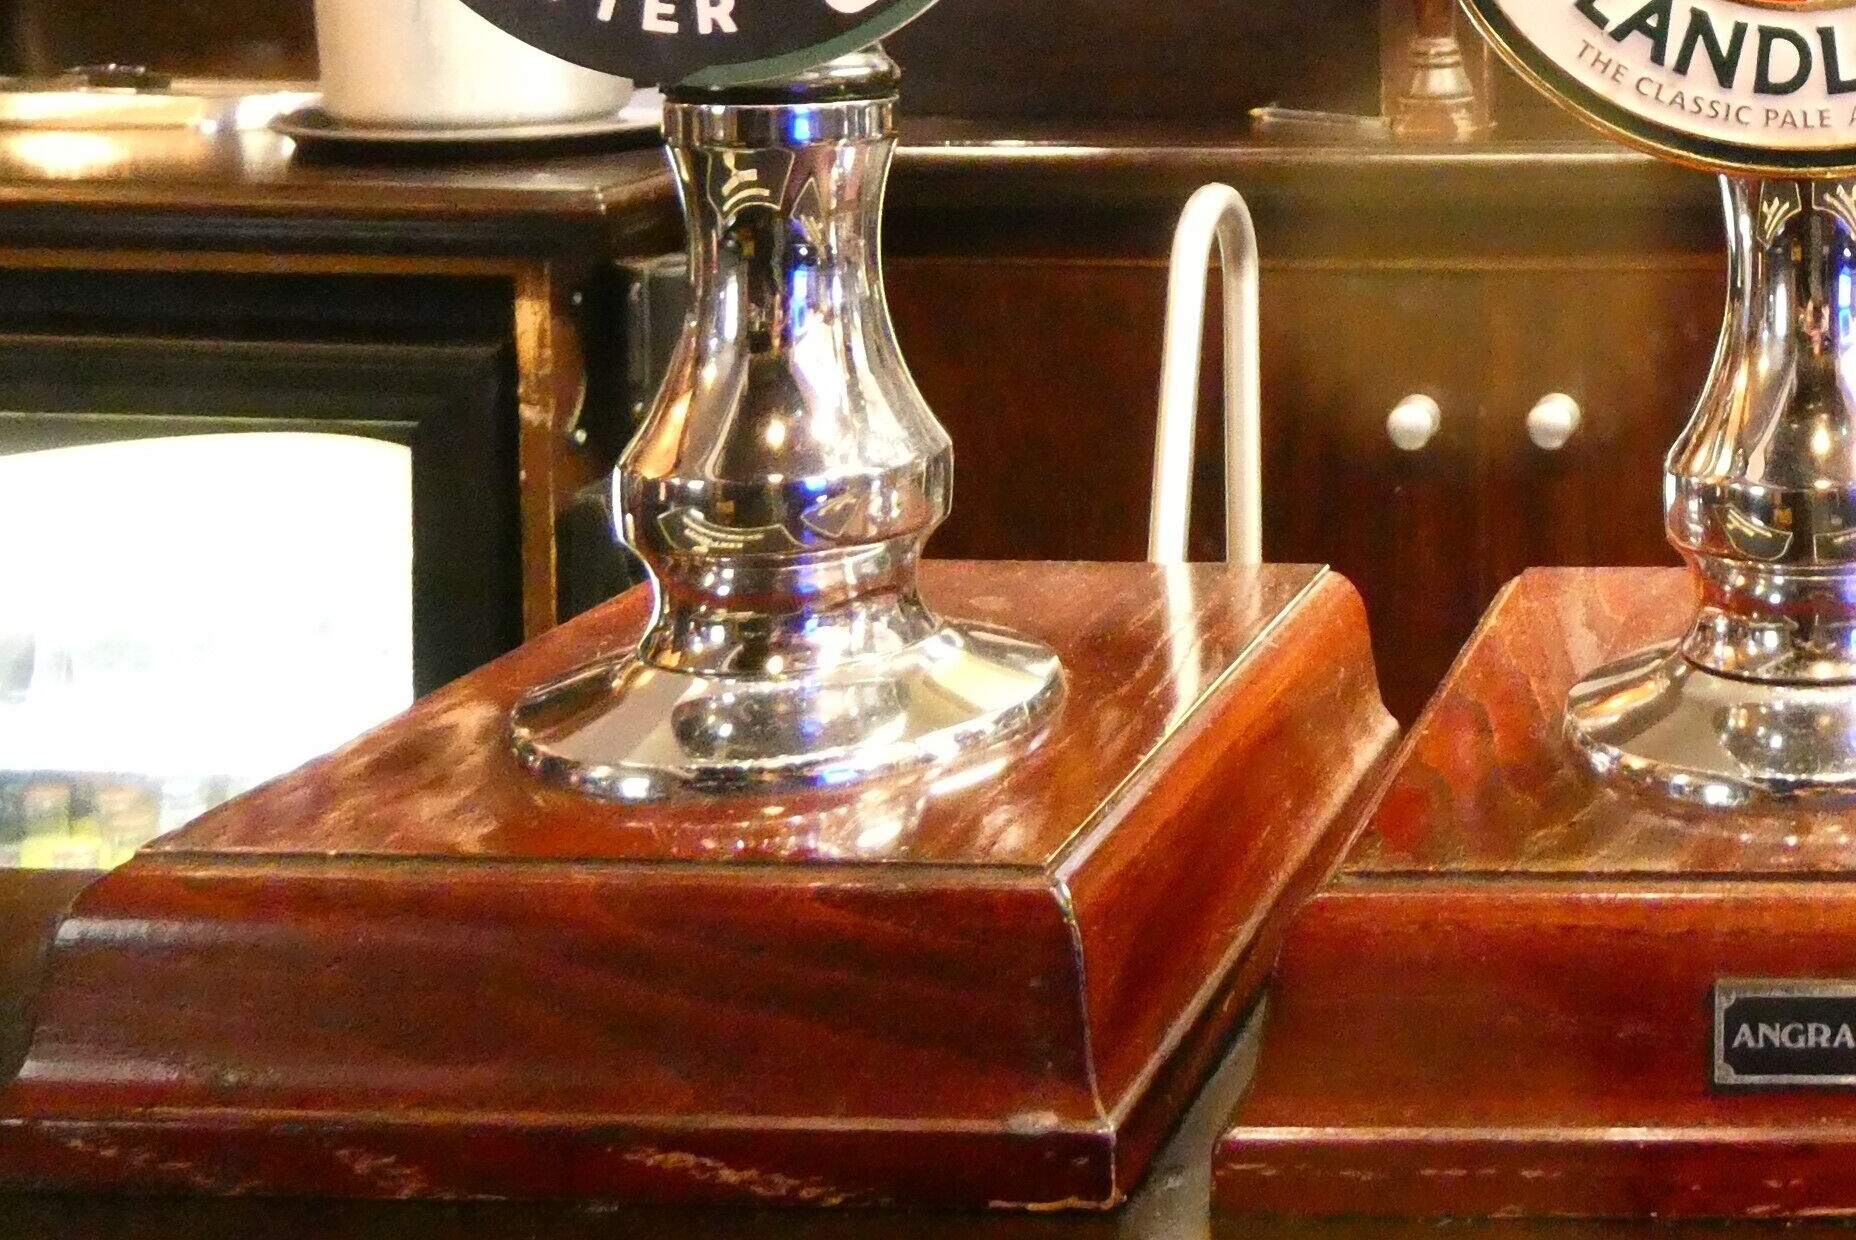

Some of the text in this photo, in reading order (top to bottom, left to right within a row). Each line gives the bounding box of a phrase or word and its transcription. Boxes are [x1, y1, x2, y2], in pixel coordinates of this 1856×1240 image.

[1576, 39, 1627, 86] THE
[1634, 75, 1753, 127] CLASSIC
[1762, 107, 1833, 130] PALE
